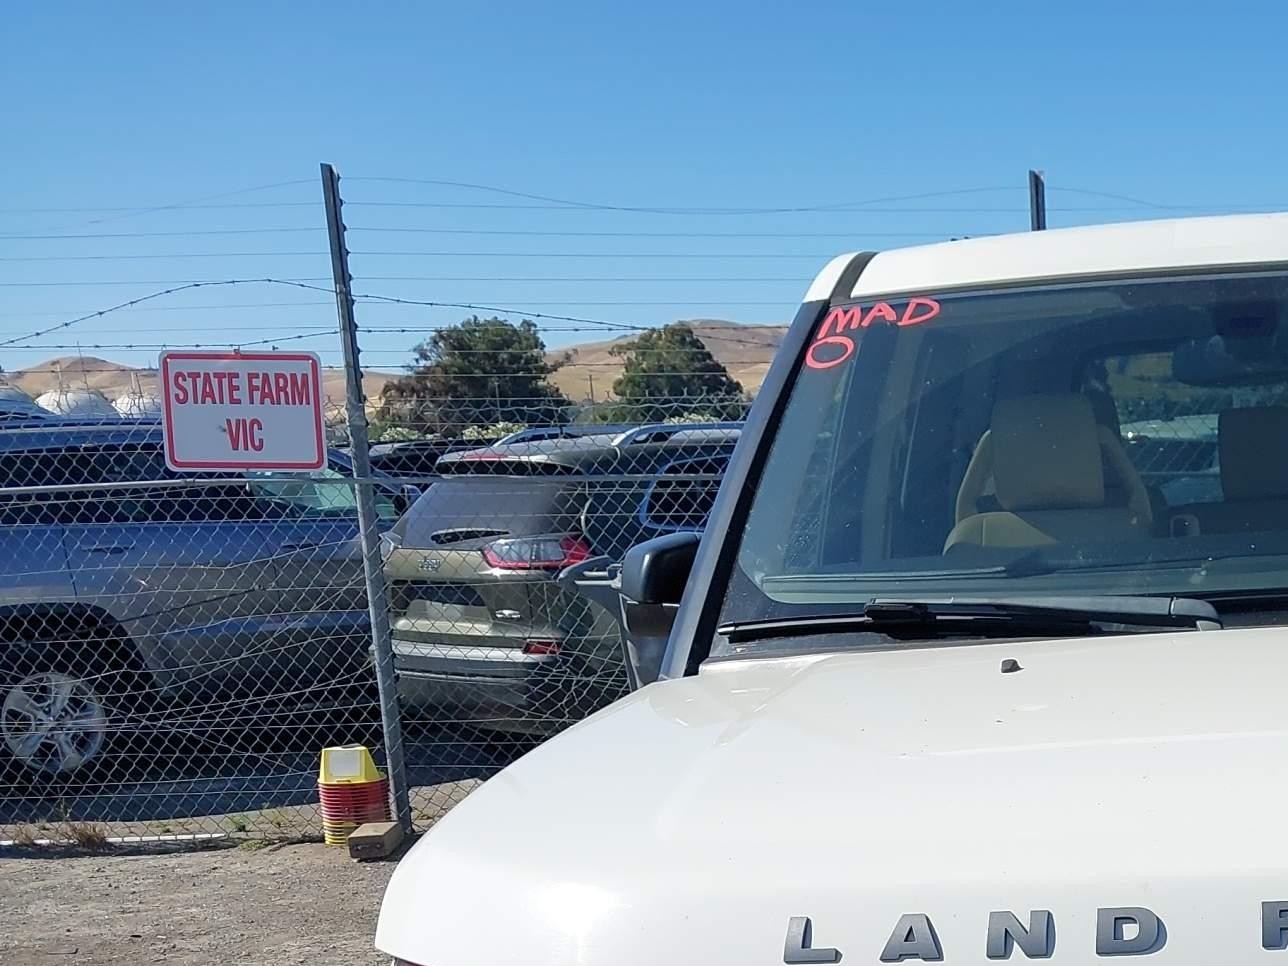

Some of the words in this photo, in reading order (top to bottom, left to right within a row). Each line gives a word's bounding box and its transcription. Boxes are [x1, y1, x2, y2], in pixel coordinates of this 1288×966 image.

[816, 297, 940, 339] MAD
[173, 371, 242, 405] STATE
[247, 372, 311, 405] FARM
[225, 418, 264, 451] VIC
[783, 906, 1168, 964] LAND
